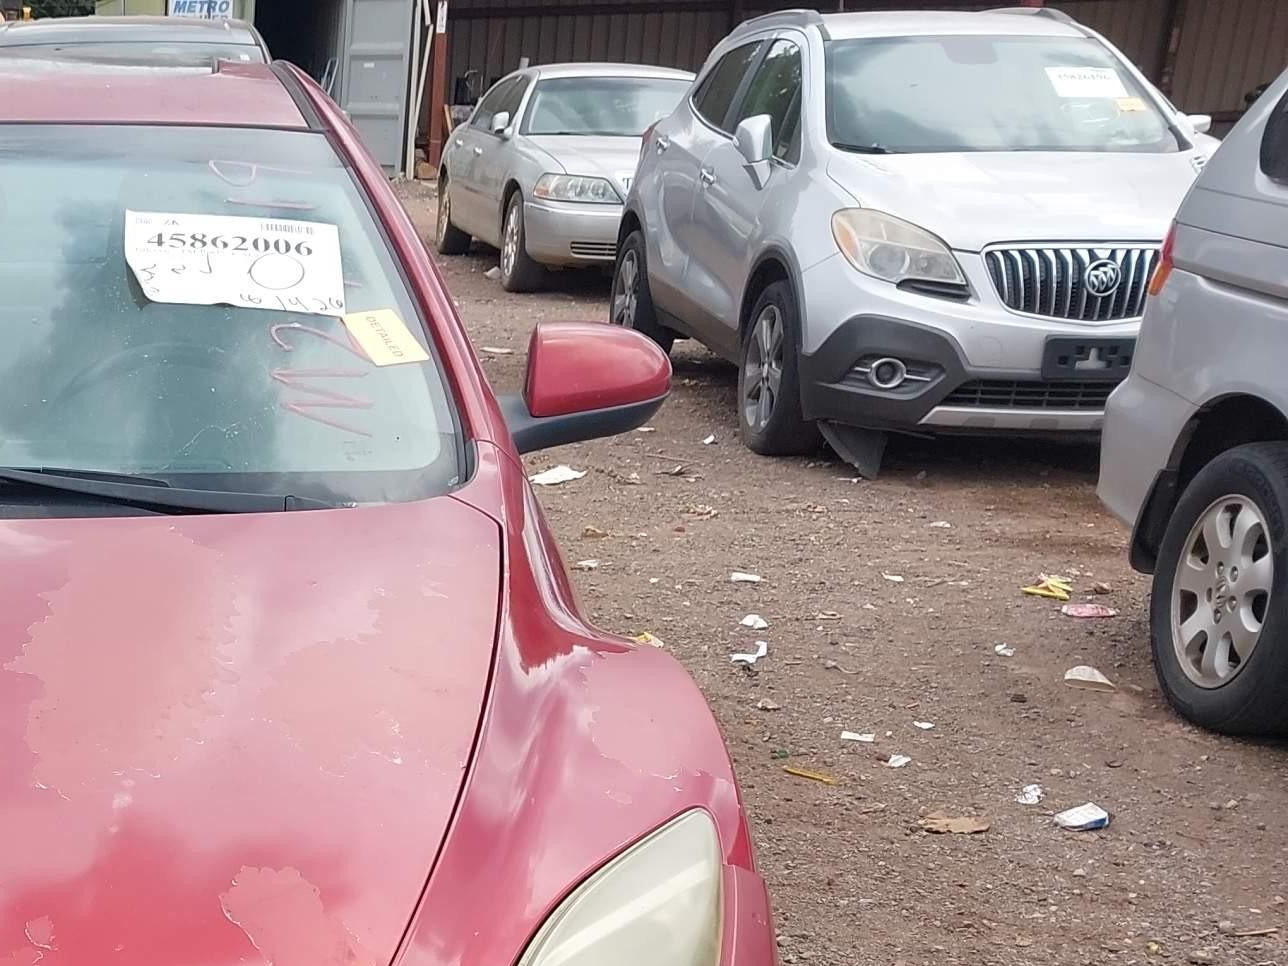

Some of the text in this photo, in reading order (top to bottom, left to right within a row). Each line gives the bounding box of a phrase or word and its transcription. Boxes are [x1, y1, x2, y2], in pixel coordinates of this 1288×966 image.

[173, 0, 230, 14] METRO
[146, 232, 314, 257] 45862006
[366, 315, 404, 359] DETAILED
